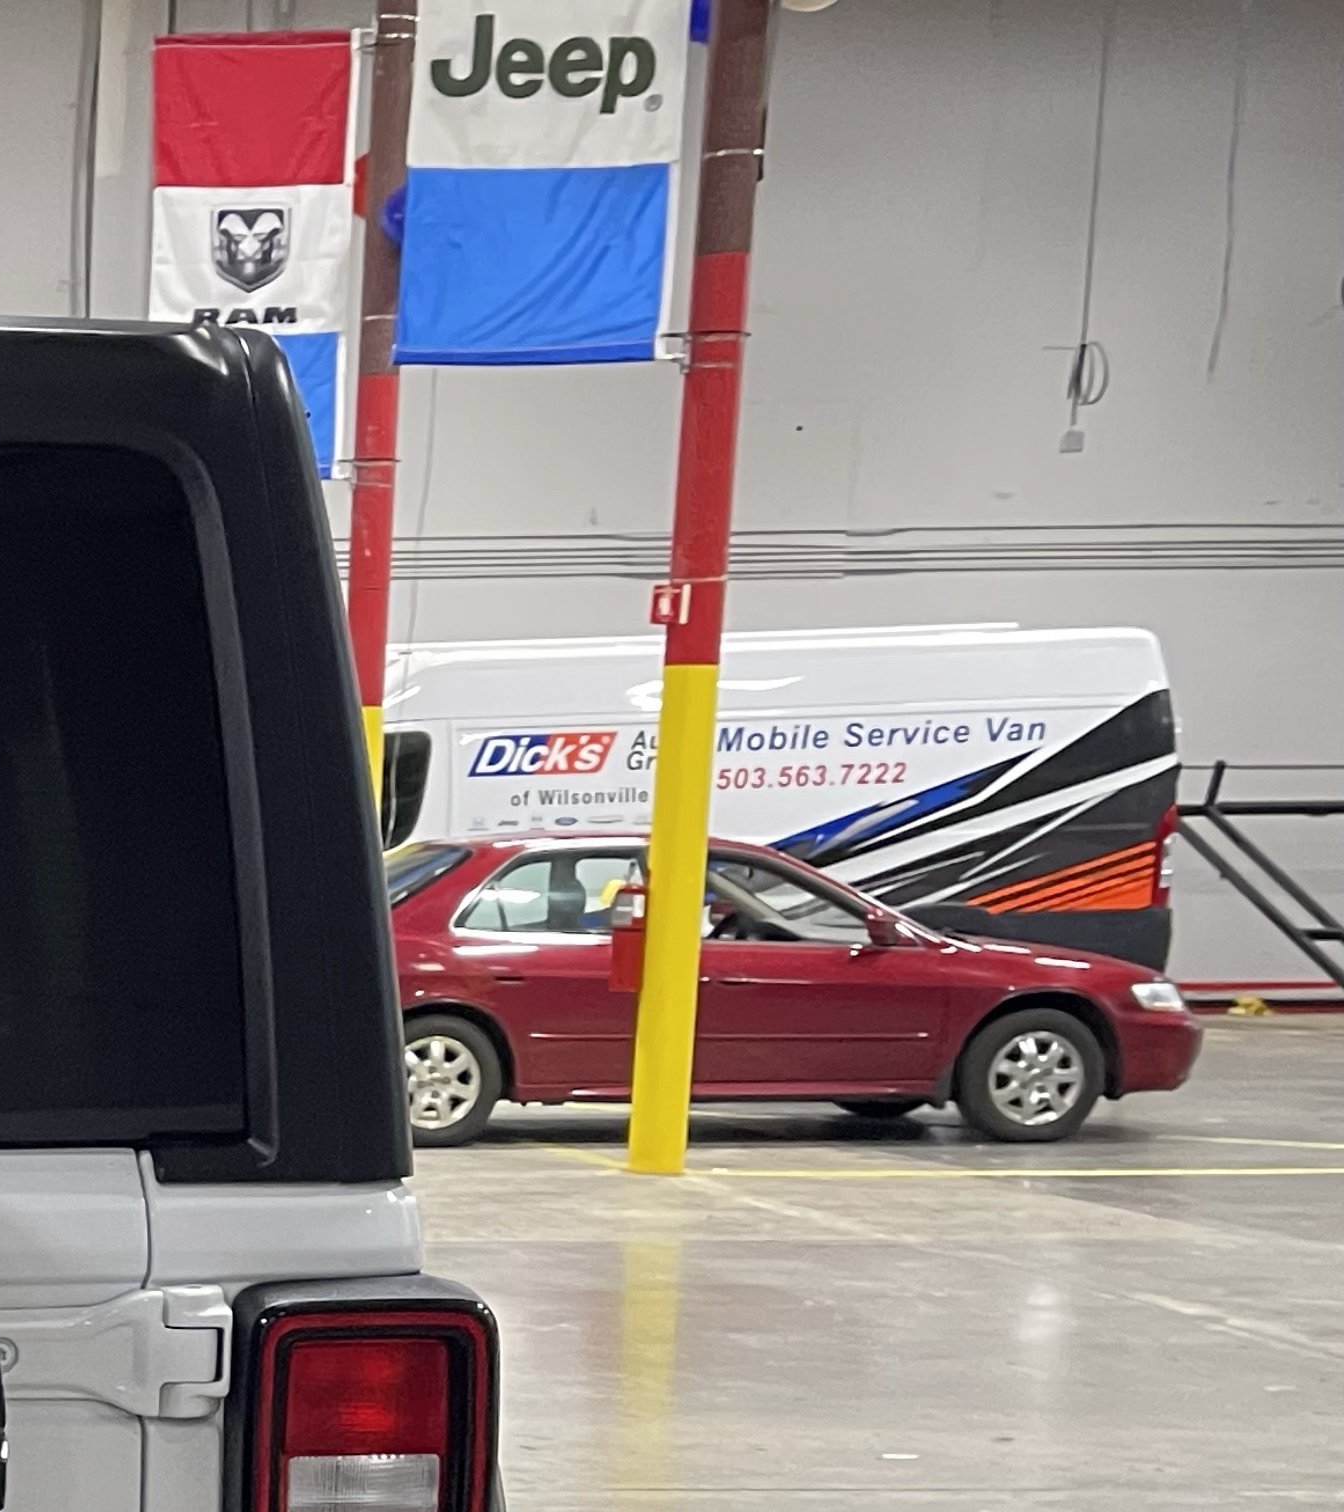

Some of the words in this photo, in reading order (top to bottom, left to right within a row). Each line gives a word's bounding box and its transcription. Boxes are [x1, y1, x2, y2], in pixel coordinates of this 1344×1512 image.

[430, 13, 657, 115] Jeep
[192, 306, 298, 325] RAM
[716, 724, 830, 752] Mobile
[843, 720, 972, 748] Service
[985, 716, 1048, 743] Van
[474, 734, 606, 774] Dick's
[716, 761, 908, 791] 503.563.7222
[509, 789, 531, 807] of
[538, 786, 649, 806] Wilsonville
